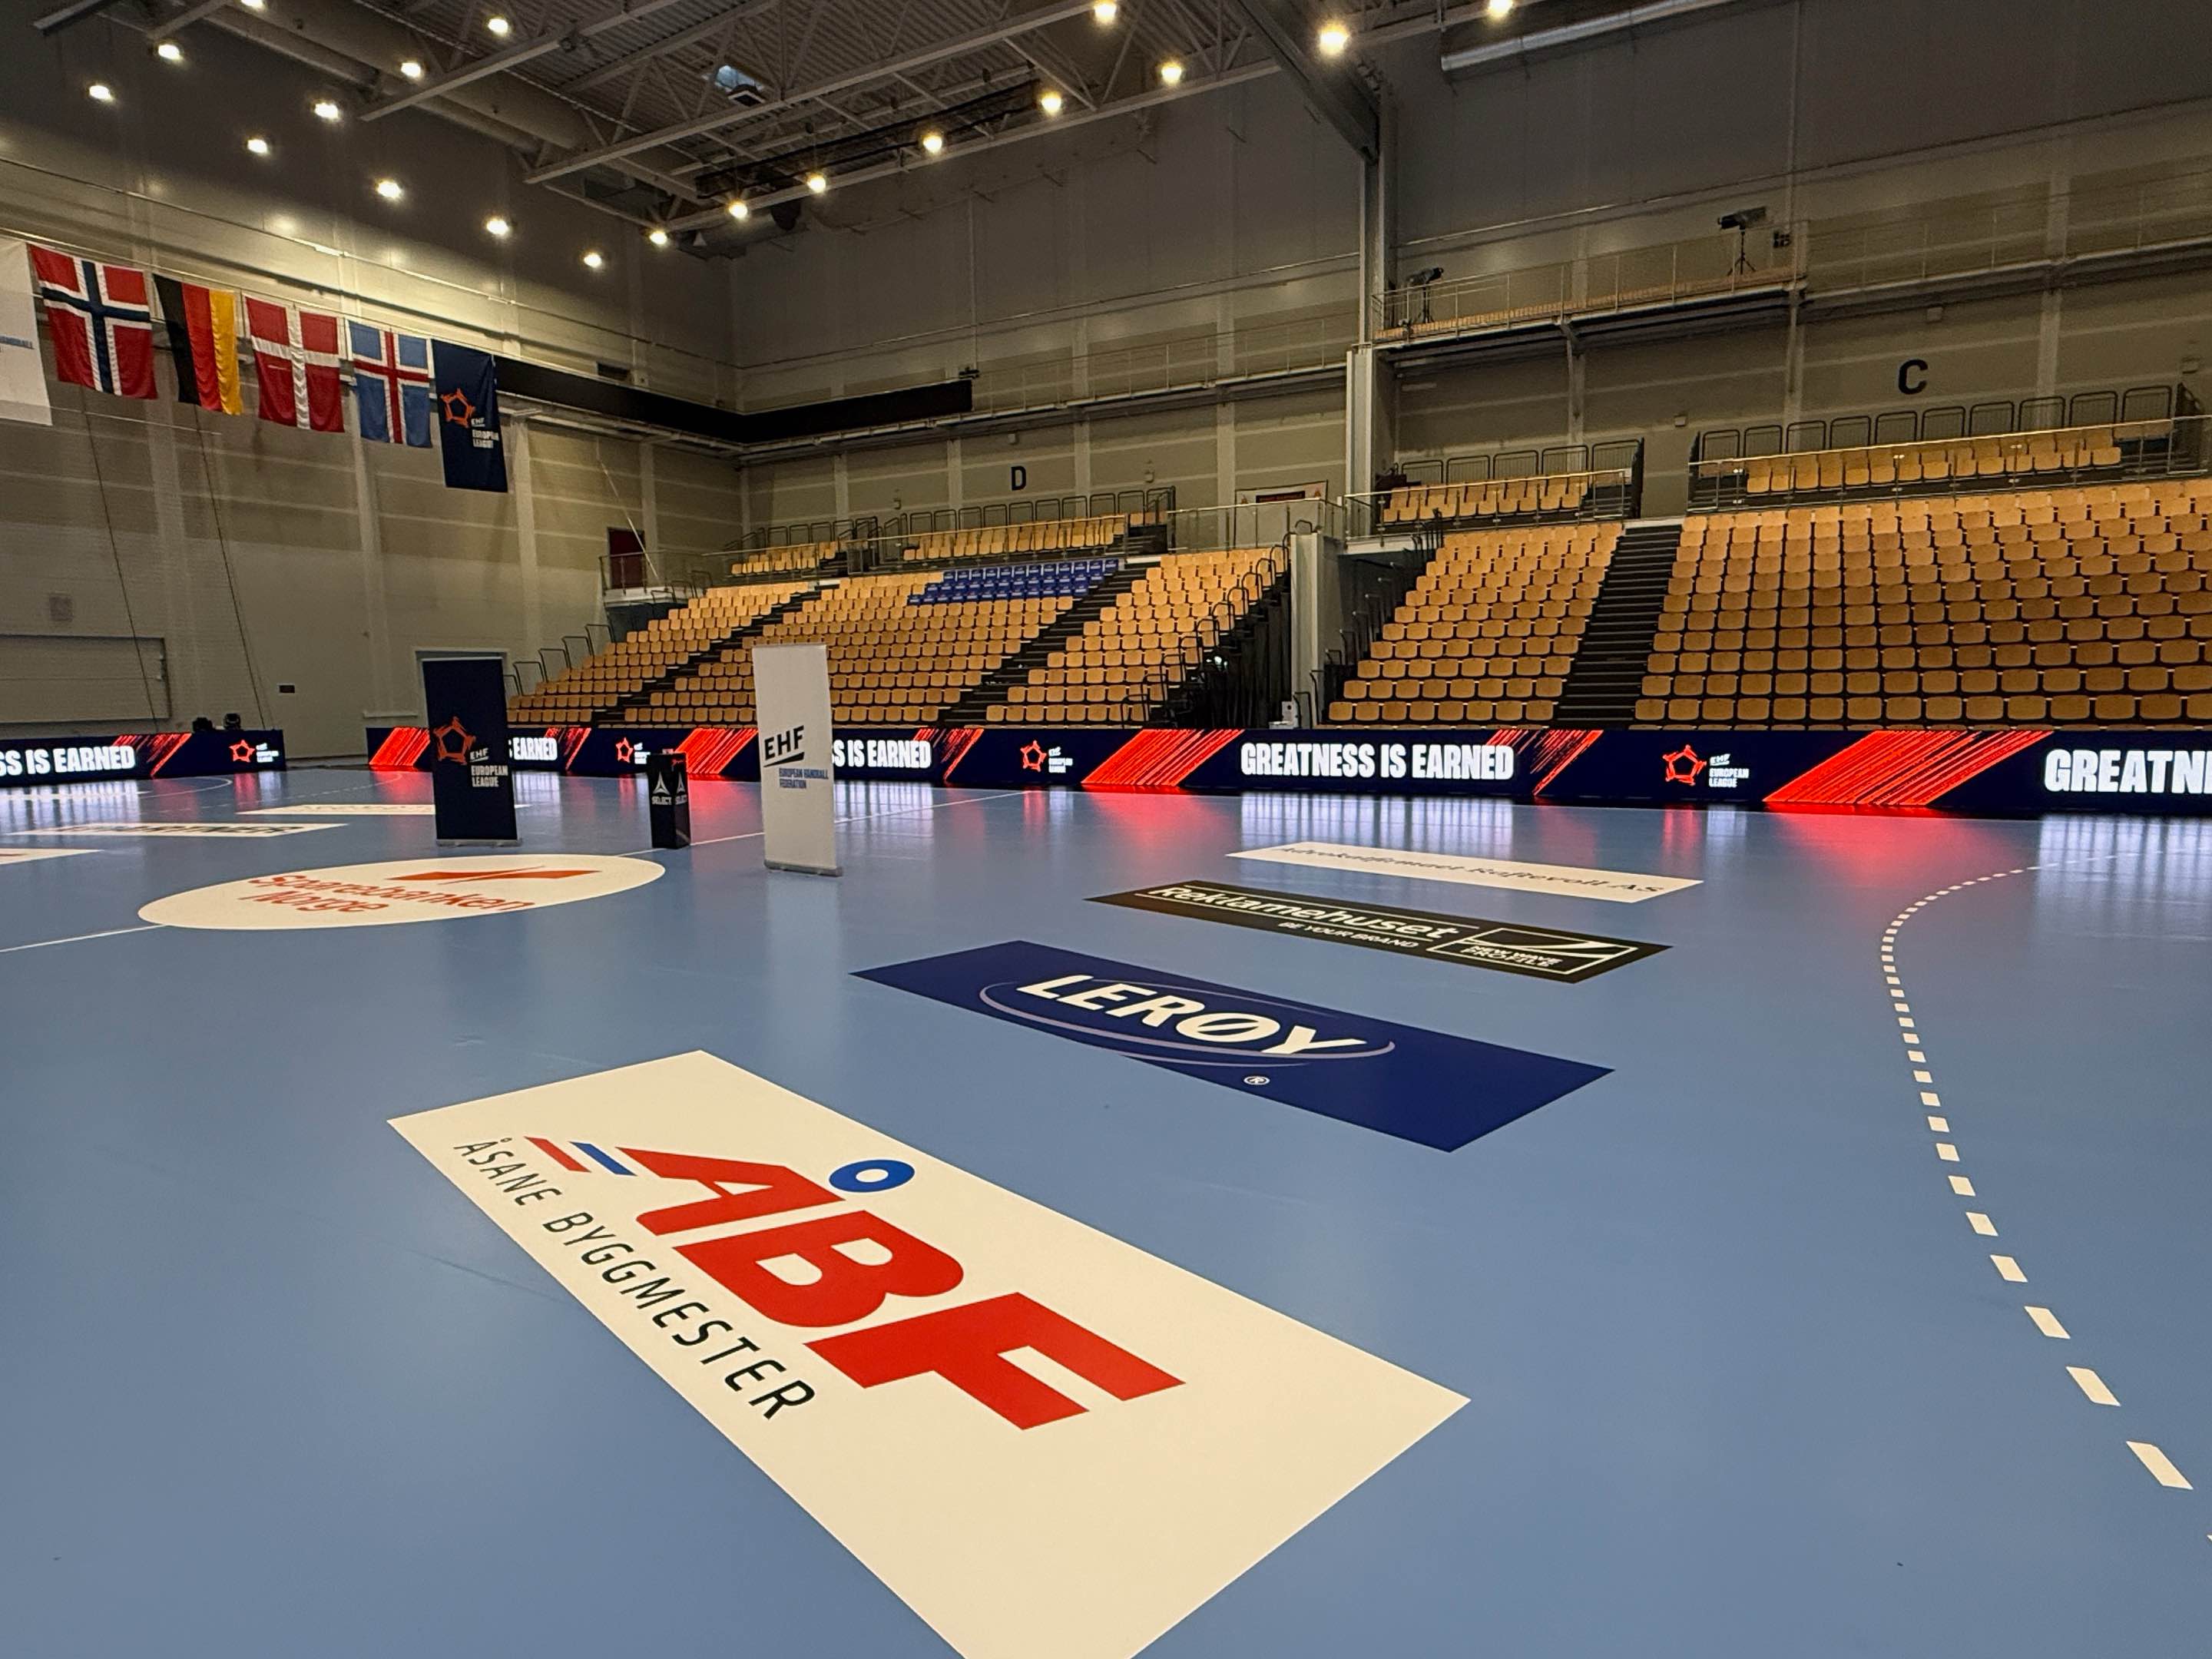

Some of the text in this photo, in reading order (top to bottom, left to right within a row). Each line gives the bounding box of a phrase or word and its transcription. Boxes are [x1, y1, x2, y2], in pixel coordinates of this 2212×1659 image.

[1898, 359, 1929, 395] C
[1011, 465, 1027, 492] D
[469, 747, 488, 760] EHF
[513, 737, 558, 761] EARNED
[764, 725, 805, 761] EHF
[847, 740, 865, 767] IS
[867, 740, 932, 769] EARNED
[25, 749, 51, 775] IS
[52, 745, 136, 773] EARNED
[471, 765, 508, 776] EUROPEAN
[1240, 743, 1515, 780] GREATNESS IS EARNED
[472, 777, 499, 787] LEAGUE
[779, 768, 829, 780] EUROPEAN HANDBALL
[779, 779, 806, 789] FEDERATION
[1709, 768, 1750, 779] EUROPEAN
[1709, 777, 1737, 788] LEAGUE
[651, 795, 673, 806] SELECT
[248, 875, 535, 911] Sparebanken
[1608, 883, 1665, 892] AS
[239, 890, 389, 912] Norge
[1148, 886, 1459, 939] Reklamehuset
[1277, 922, 1419, 949] BE YOUR BRAND
[1460, 948, 1556, 967] PROFILE
[1017, 975, 1366, 1055] LERØY
[453, 1137, 816, 1420] ÅSANE BYGGMESTER
[615, 1147, 1187, 1430] ÅBF
